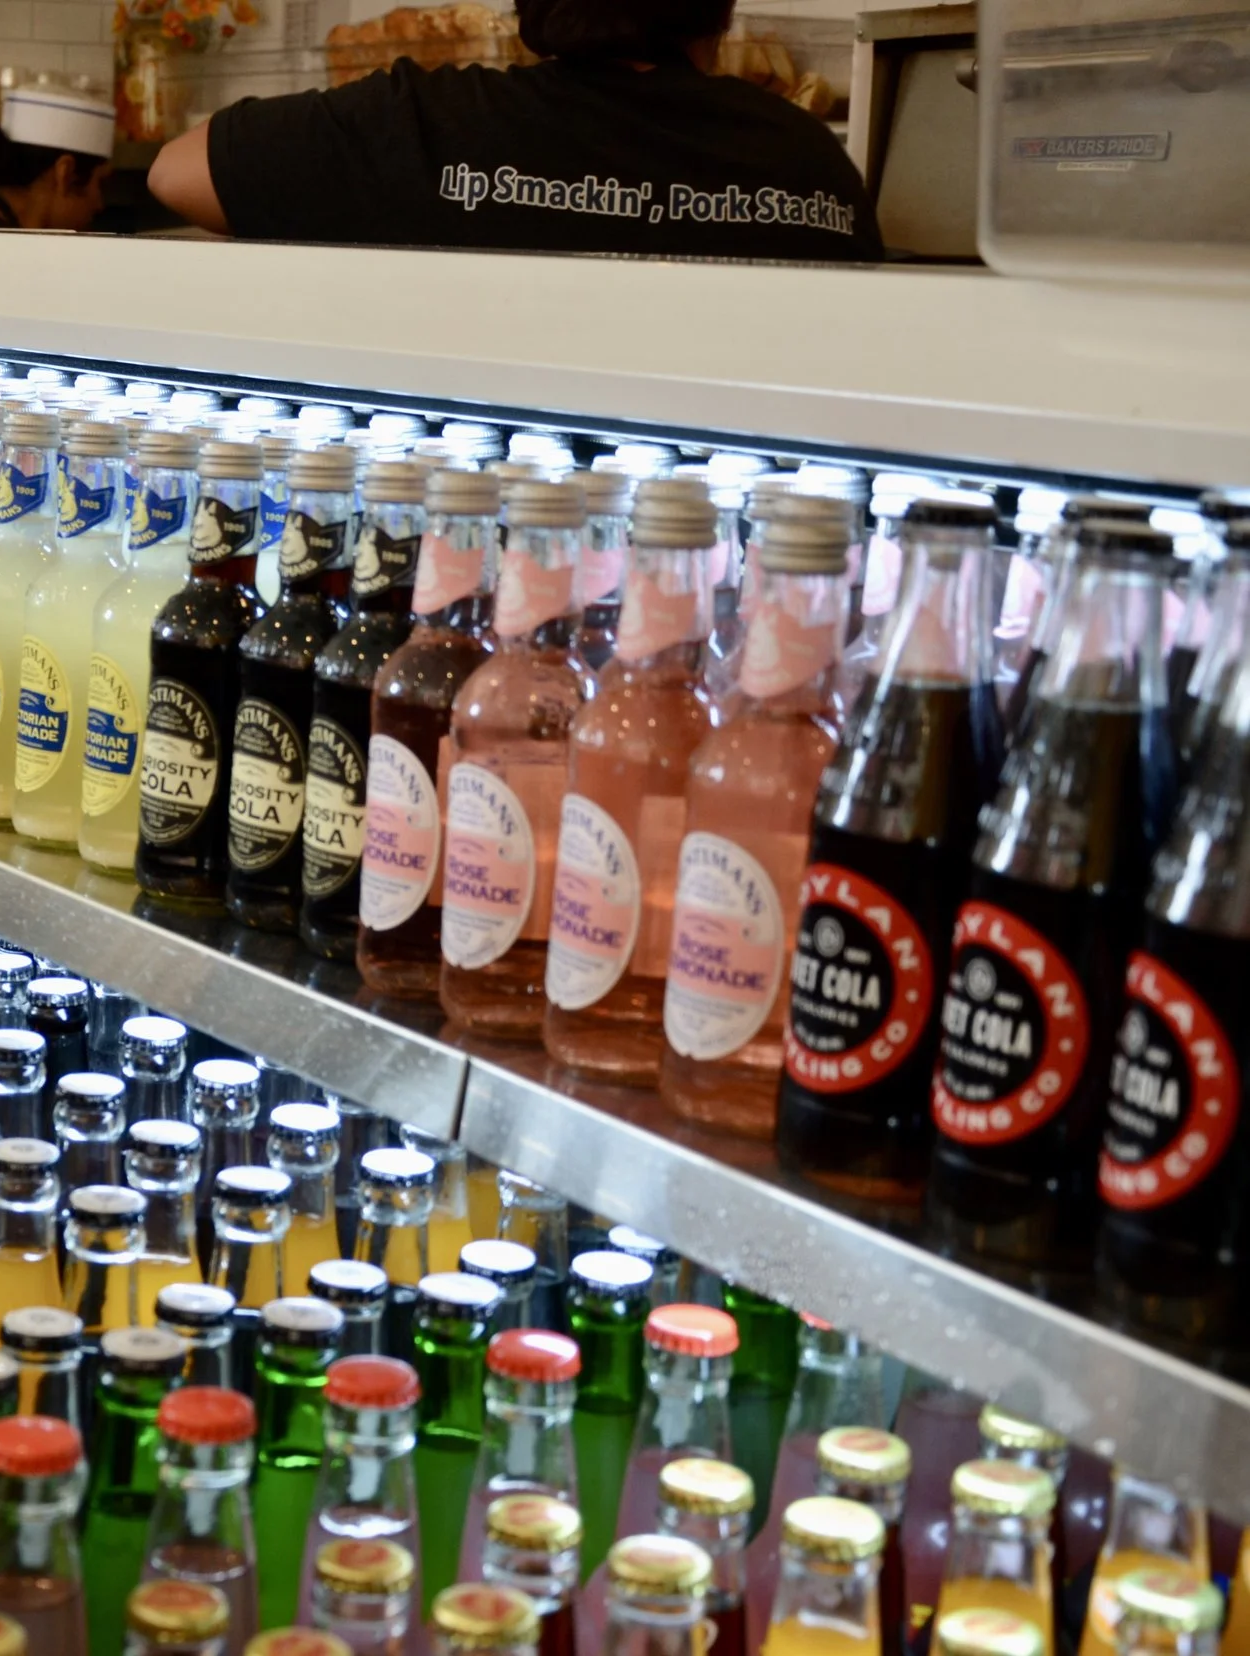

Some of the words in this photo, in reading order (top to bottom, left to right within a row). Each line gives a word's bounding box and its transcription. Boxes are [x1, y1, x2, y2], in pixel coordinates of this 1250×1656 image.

[440, 163, 488, 211] Lip
[670, 184, 752, 222] Pork
[364, 846, 427, 870] ONADE
[821, 963, 881, 1010] COLA
[971, 1008, 1032, 1060] COLA
